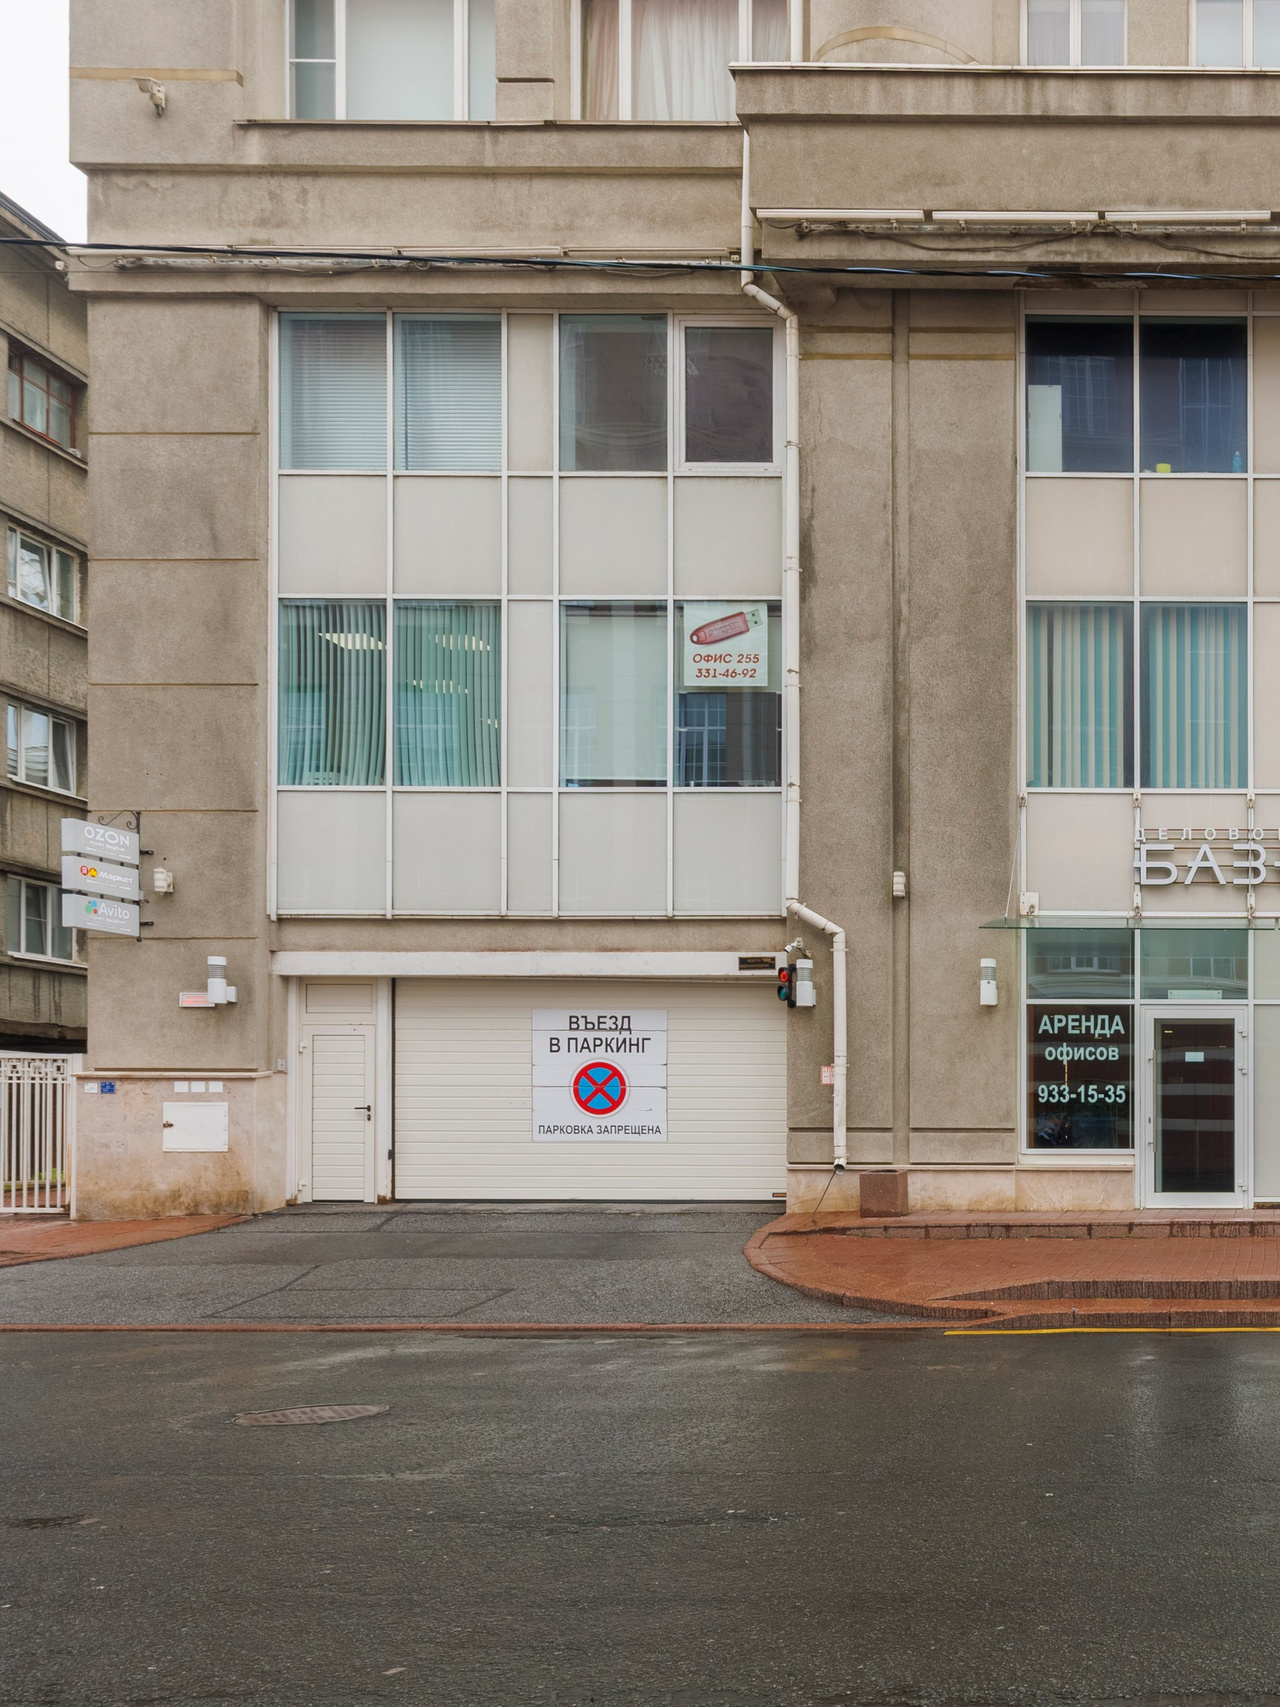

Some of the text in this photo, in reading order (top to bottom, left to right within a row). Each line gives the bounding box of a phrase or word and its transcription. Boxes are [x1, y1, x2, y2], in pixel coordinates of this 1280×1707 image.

[693, 653, 760, 664] ОФИС 255
[695, 668, 757, 679] 331-46-92
[84, 826, 130, 847] OZON
[98, 870, 133, 884] Маркет
[99, 903, 130, 919] Avito
[569, 1015, 632, 1035] ВЪЕЗД
[1038, 1014, 1125, 1038] АРЕНДА
[549, 1037, 651, 1053] В ПАРКИНГ
[1045, 1042, 1119, 1065] офисов
[1038, 1084, 1126, 1103] 933-15-35
[538, 1125, 662, 1136] ПАРКОВКА ЗАПРЕЩЕНА
